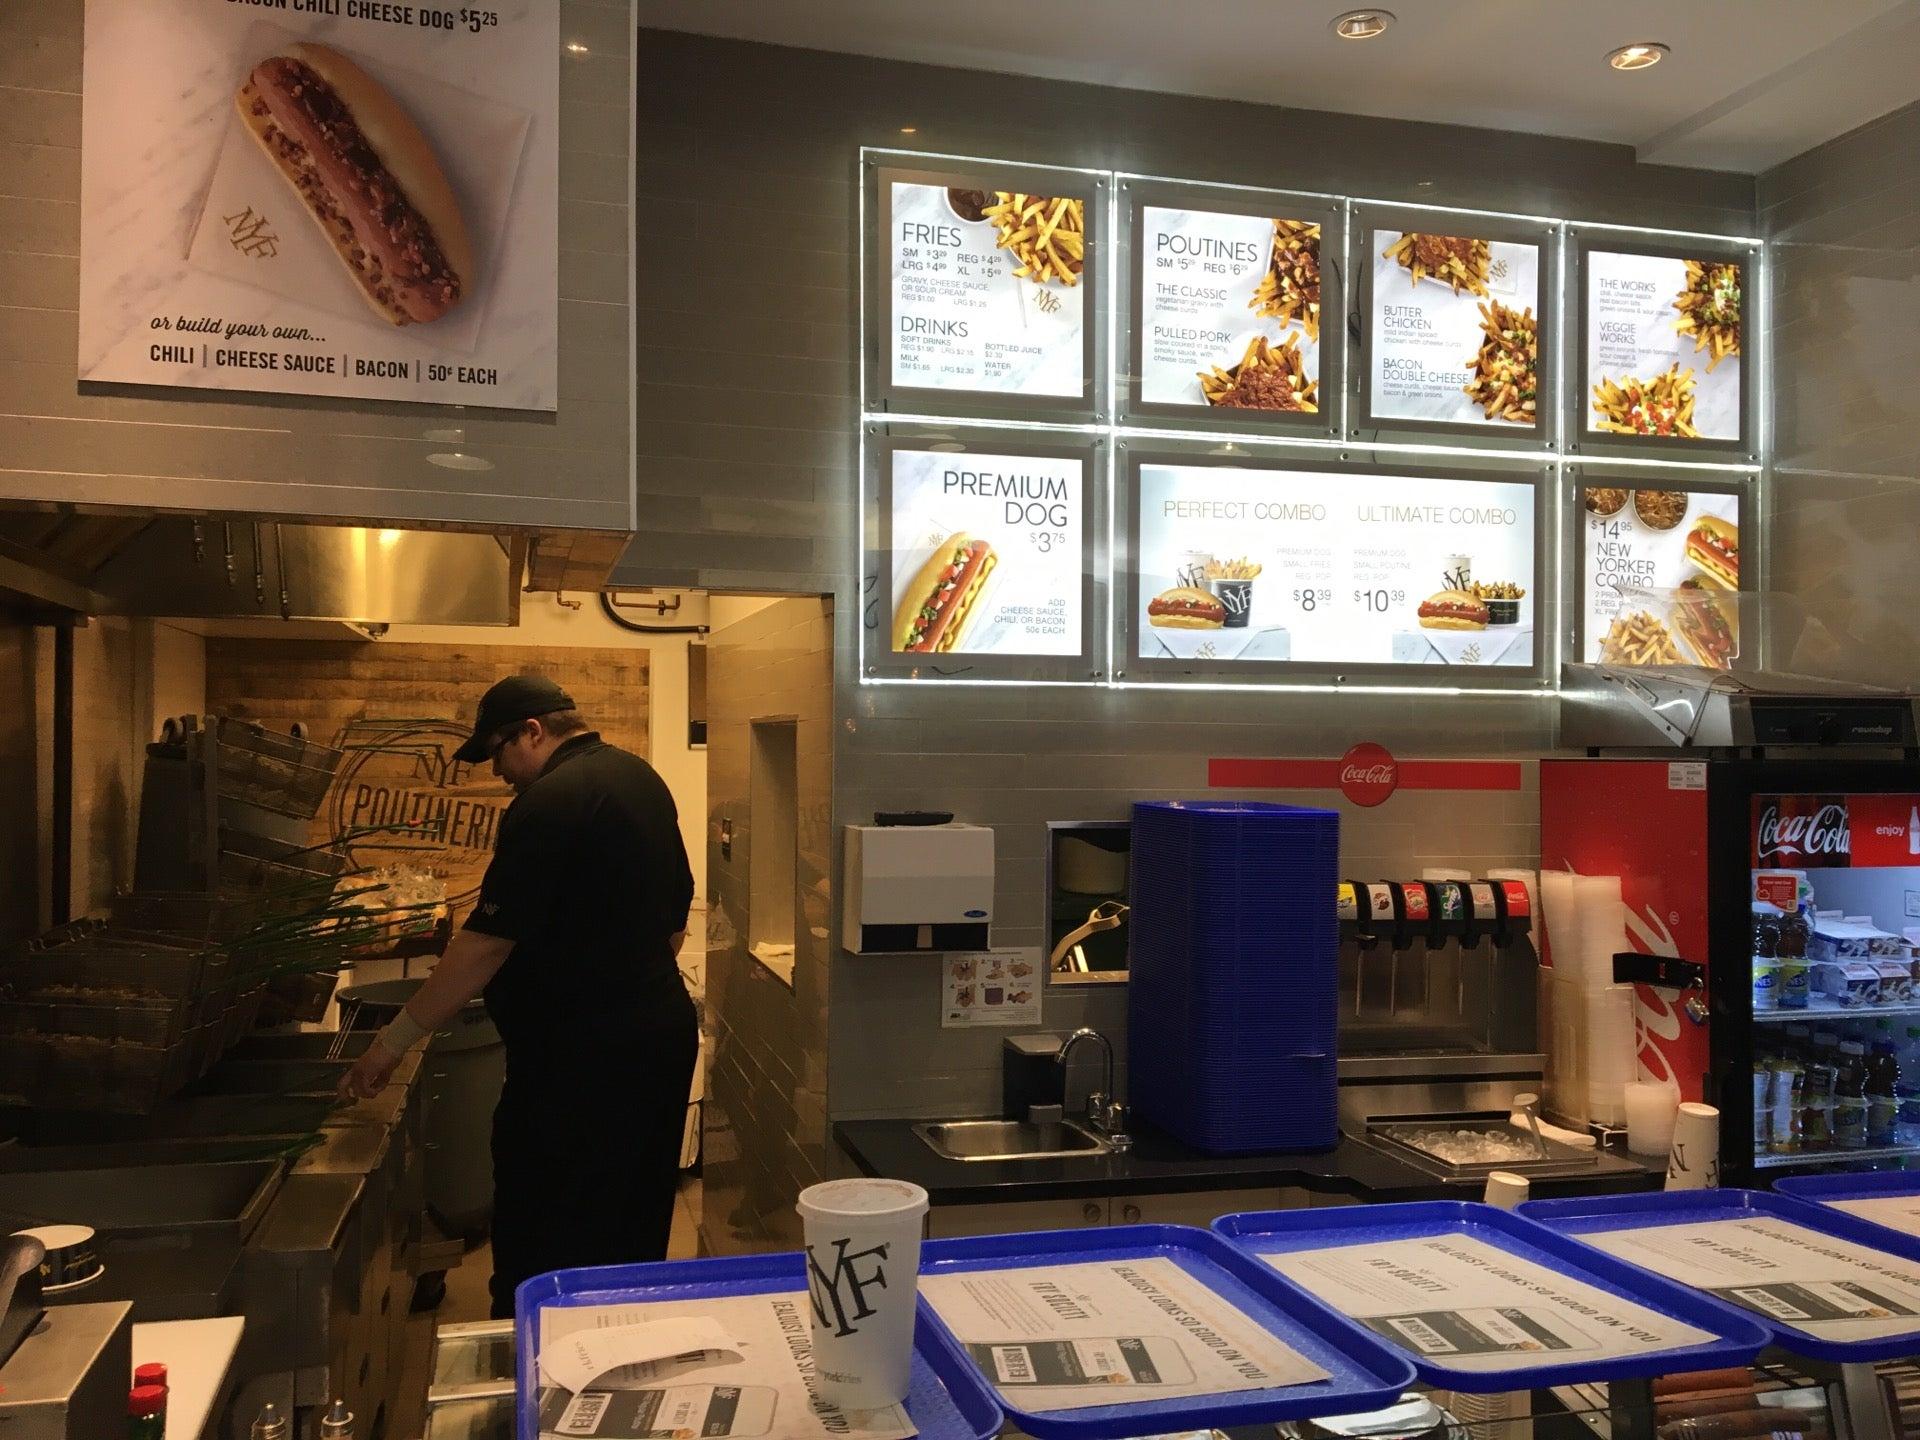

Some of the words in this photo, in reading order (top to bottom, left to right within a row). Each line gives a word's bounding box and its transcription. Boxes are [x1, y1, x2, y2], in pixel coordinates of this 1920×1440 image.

[347, 3, 413, 25] CHEESE
[419, 10, 454, 30] DOG
[903, 223, 961, 247] FRIES
[903, 248, 918, 257] SM
[957, 253, 978, 264] REG
[1158, 233, 1257, 262] POUTINES
[903, 261, 923, 270] LRG
[957, 267, 970, 275] XL
[1156, 257, 1173, 267] SM
[1204, 263, 1226, 273] REG
[915, 285, 936, 293] SOUR
[939, 288, 966, 296] CREAM
[930, 278, 960, 288] CHEESE
[1156, 283, 1178, 295] THE
[1181, 286, 1227, 300] CLASSIC
[1600, 278, 1618, 289] THE
[1621, 280, 1656, 293] WORKS
[1384, 305, 1422, 317] BUTTER
[150, 317, 172, 330] or
[176, 316, 222, 334] build
[225, 323, 269, 340] your
[272, 326, 326, 342] own...
[901, 316, 968, 337] DRINKS
[1384, 317, 1431, 329] CHICKEN
[1600, 321, 1636, 333] VEGGIE
[901, 335, 920, 343] SOFT
[923, 337, 951, 346] DRINKS
[1155, 326, 1197, 339] PULLED
[1200, 331, 1231, 343] PORK
[1600, 332, 1635, 344] WORKS
[985, 343, 1019, 352] BOTTLED
[1021, 346, 1042, 354] JUICE
[150, 344, 194, 364] CHILI
[216, 349, 278, 370] CHEESE
[284, 353, 336, 374] SAUCE
[355, 359, 408, 379] BACON
[428, 364, 453, 382] 50¢
[457, 367, 497, 386] EACH
[985, 361, 1011, 369] WATER
[1383, 358, 1422, 369] BACON
[1383, 369, 1425, 381] DOUBLE
[1429, 372, 1468, 384] CHEESE
[944, 471, 1067, 500] PREMIUM
[1006, 501, 1067, 527] DOG
[1164, 501, 1249, 519] PERFECT
[1255, 503, 1326, 520] COMBO
[1358, 505, 1444, 523] ULTIMATE
[1449, 507, 1516, 525] COMBO
[1598, 542, 1631, 557] NEW
[1596, 557, 1655, 574] YORKER
[1595, 573, 1653, 588] COMBO
[1341, 764, 1394, 784] Coca-Cola
[1757, 804, 1850, 858] Coca-Cola
[1875, 824, 1905, 837] enjoy
[1110, 1267, 1161, 1294] JEALOUSY
[1363, 1258, 1396, 1269] FRY
[1387, 1269, 1450, 1292] SOCIETY
[1028, 1282, 1061, 1293] FRY
[1042, 1294, 1090, 1320] SOCIETY
[1147, 1295, 1188, 1316] LOOKS
[1483, 1267, 1534, 1286] LOOKS
[1528, 1286, 1555, 1295] SO
[1550, 1296, 1599, 1315] GOOD
[1594, 1316, 1625, 1326] ON
[1621, 1326, 1662, 1342] YOU
[771, 1300, 805, 1334] JEALOUSY
[1175, 1316, 1202, 1326] SO
[1188, 1328, 1228, 1348] GOOD
[785, 1335, 814, 1361] LOOKS
[1216, 1349, 1245, 1361] ON
[1232, 1362, 1268, 1380] YOU
[820, 1414, 850, 1434] YOU
